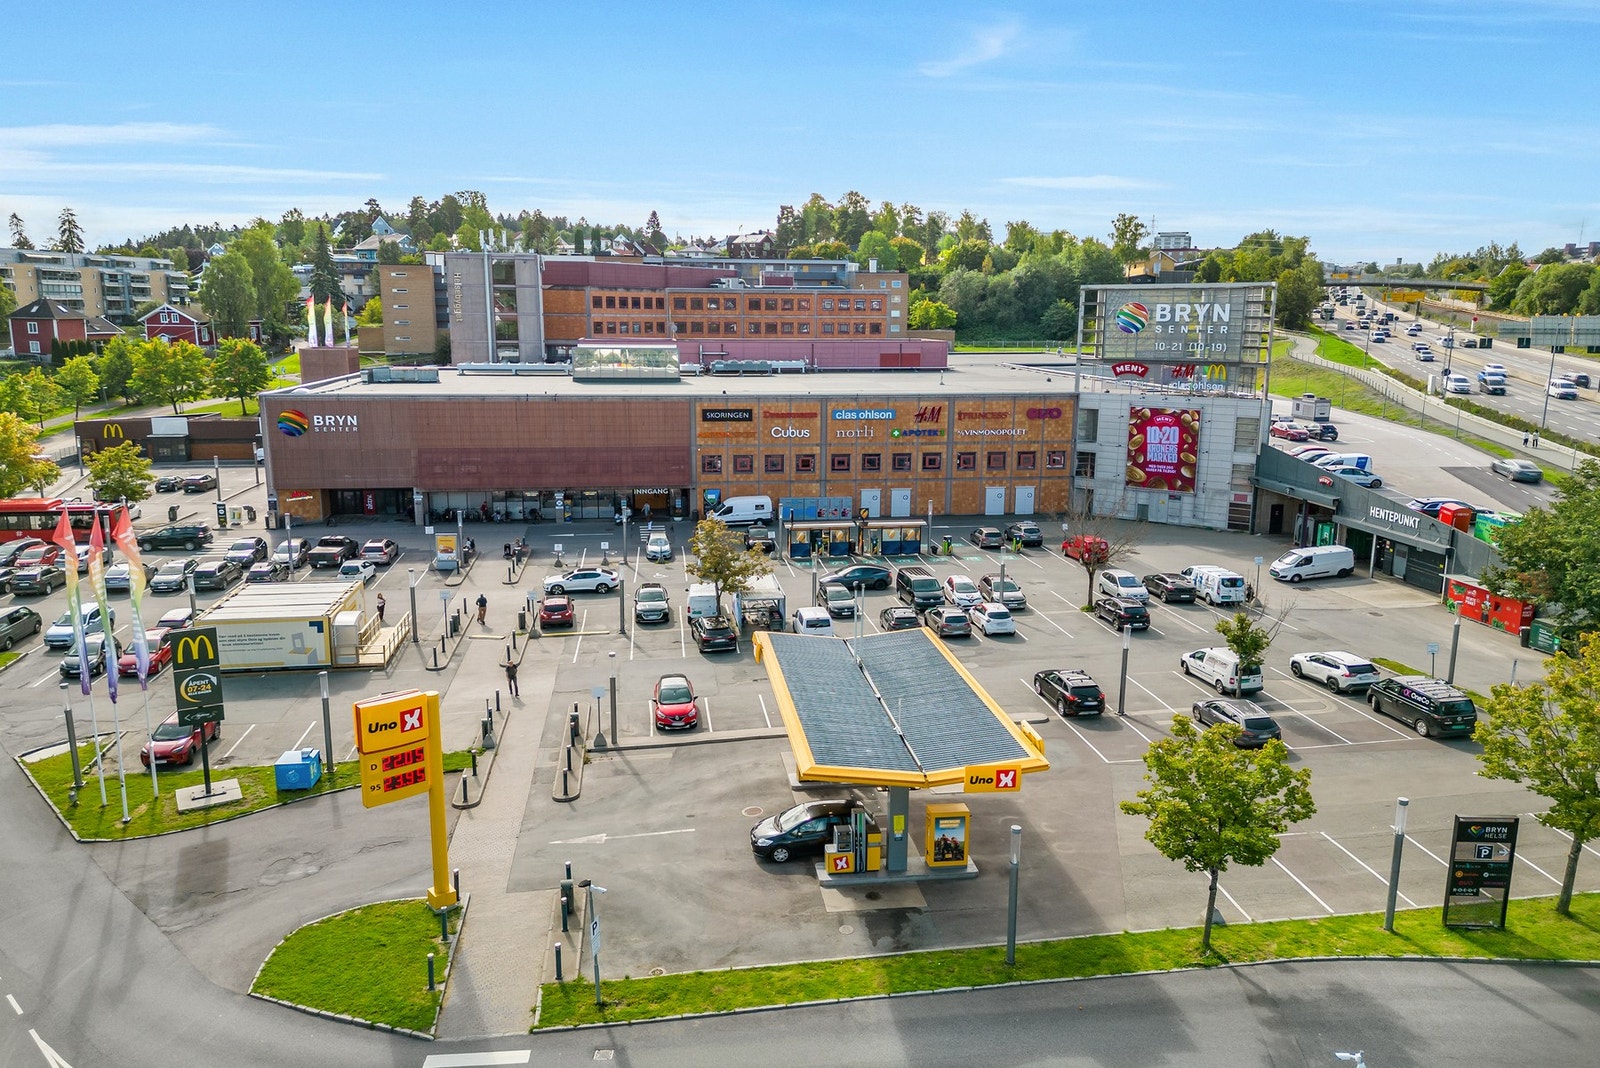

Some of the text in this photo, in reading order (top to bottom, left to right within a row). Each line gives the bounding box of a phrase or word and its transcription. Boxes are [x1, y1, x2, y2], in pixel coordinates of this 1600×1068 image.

[1156, 303, 1231, 322] BRYN
[1155, 325, 1228, 334] SENTER
[1154, 342, 1227, 352] 10-21 (10-19)
[1116, 364, 1145, 374] MENY
[1171, 364, 1196, 378] H&M
[1172, 380, 1224, 390] clas ohlson
[314, 415, 358, 426] BRYN
[835, 410, 892, 420] clas ohlson
[914, 406, 942, 423] H&M
[771, 426, 810, 438] Cubus
[836, 426, 874, 438] norli
[1370, 506, 1420, 529] HENTEPUNKT
[187, 684, 211, 692] 07-24
[1411, 692, 1430, 705] OneCo
[368, 708, 421, 733] Uno X
[970, 771, 1015, 787] Uno X
[1481, 850, 1490, 858] P
[836, 857, 848, 870] X
[592, 921, 598, 936] P
